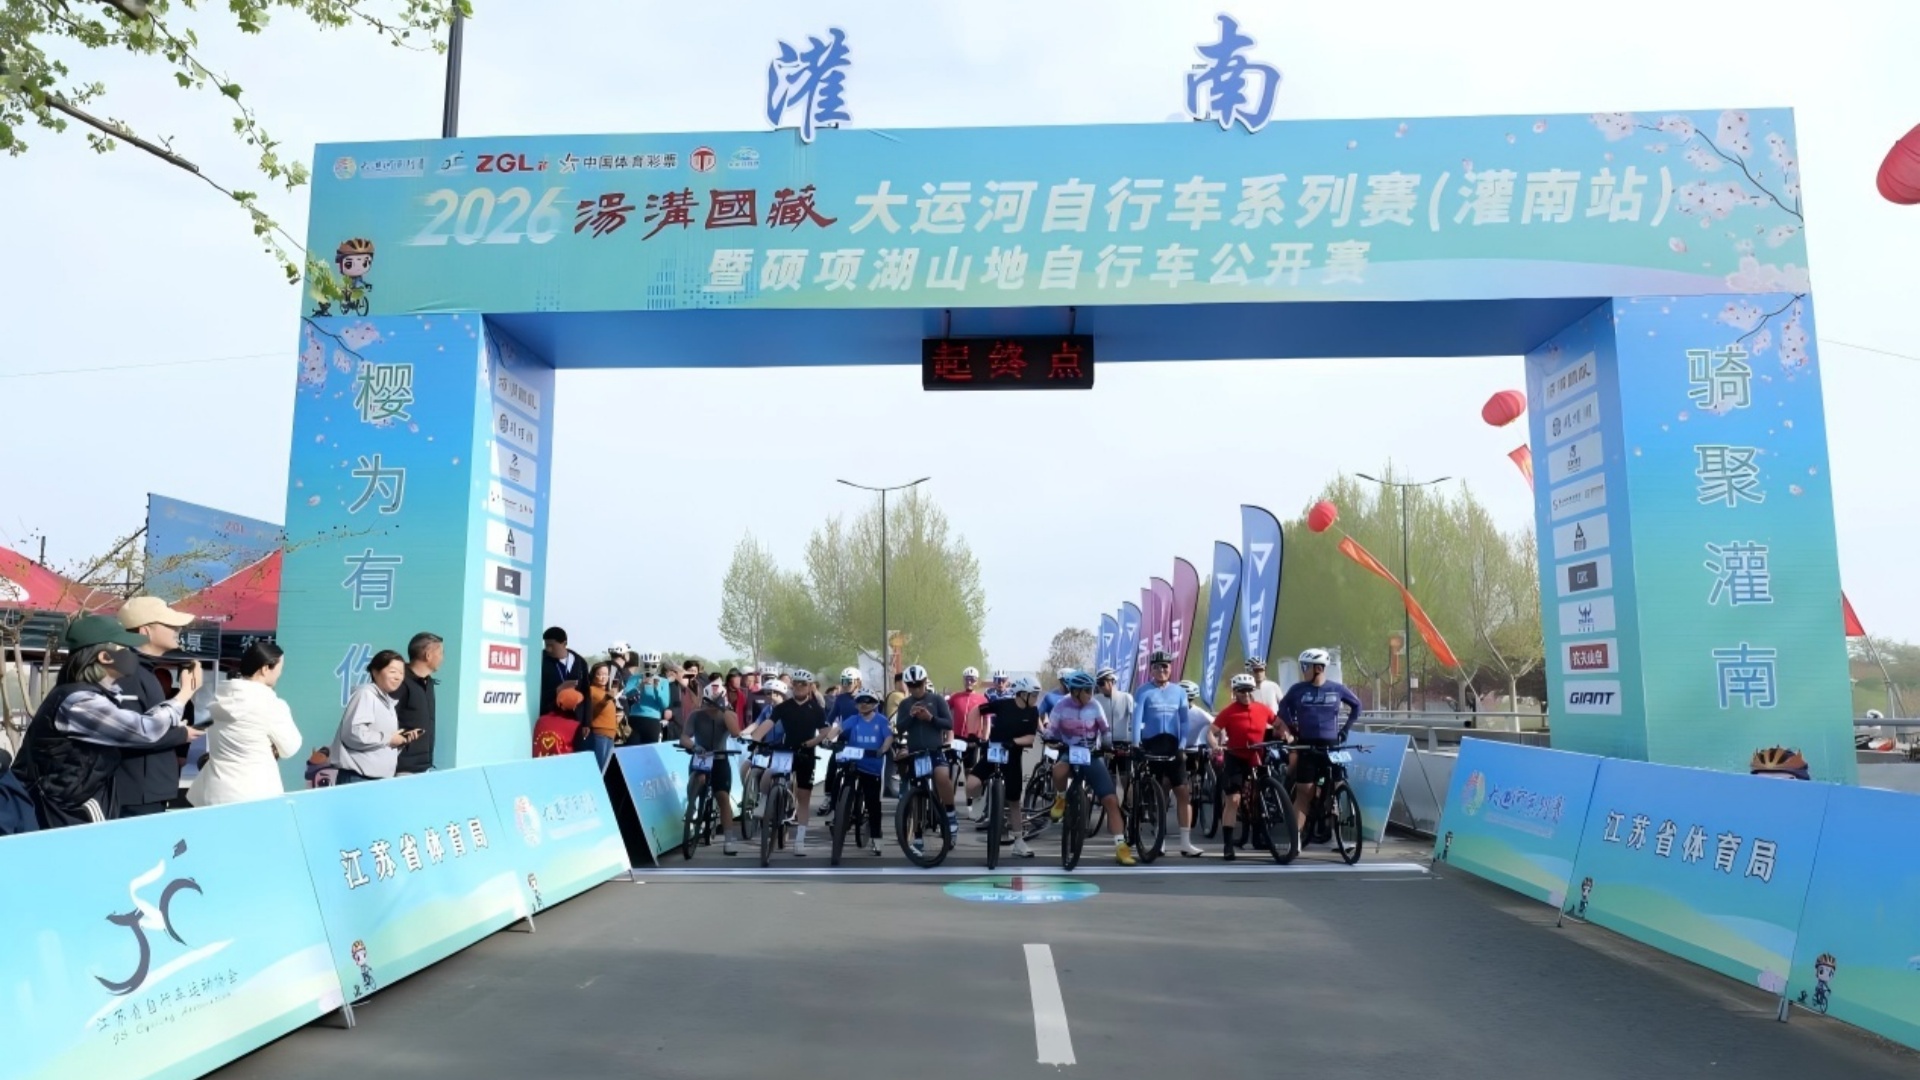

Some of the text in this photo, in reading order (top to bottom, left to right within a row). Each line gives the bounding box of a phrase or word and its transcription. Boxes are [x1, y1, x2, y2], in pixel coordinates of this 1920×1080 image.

[766, 13, 1281, 142] 灌 南
[476, 154, 534, 173] ZGL
[583, 153, 677, 169] 中国体育彩票
[412, 186, 566, 247] 2026
[849, 167, 1673, 234] 大运河自行车系列赛(灌南站)
[703, 241, 1371, 294] 暨硕项湖山地自行车公开赛
[932, 341, 1083, 379] 起终点
[1685, 344, 1778, 709] 骑聚灌南
[483, 691, 522, 704] GIANT
[1569, 691, 1615, 705] GIANT
[340, 817, 490, 890] 江苏省体育局
[1603, 810, 1778, 883] 江苏省体育局
